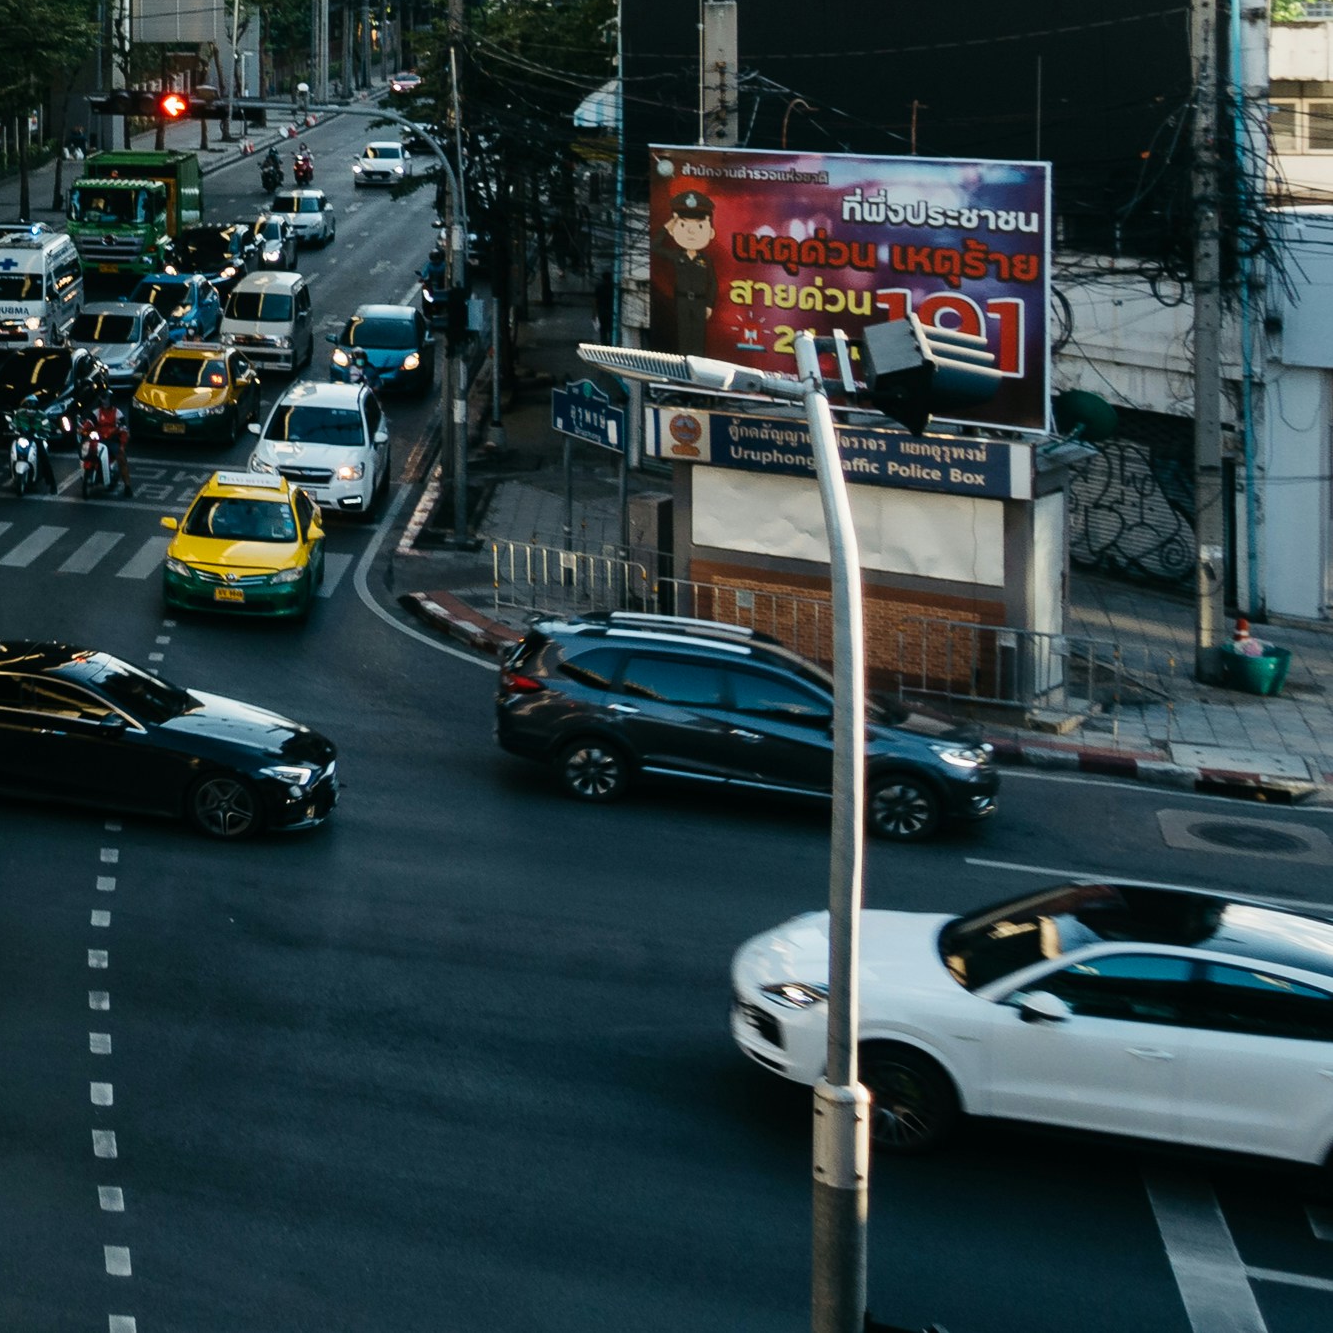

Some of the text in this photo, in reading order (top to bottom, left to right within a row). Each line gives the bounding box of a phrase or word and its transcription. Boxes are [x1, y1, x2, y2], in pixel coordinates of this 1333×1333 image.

[682, 162, 829, 185] สำนักงานตำรวจแห่งชาติ
[842, 187, 1039, 233] ที่พึ่งประชาชน
[732, 228, 1040, 286] เหตุด่วน เหตุร้าย
[729, 276, 873, 316] สายด่วน
[729, 419, 887, 452] ตู้กดสัญญาจราจร
[730, 445, 816, 470] Uruphong
[887, 461, 942, 481] Police
[949, 468, 986, 486] Box
